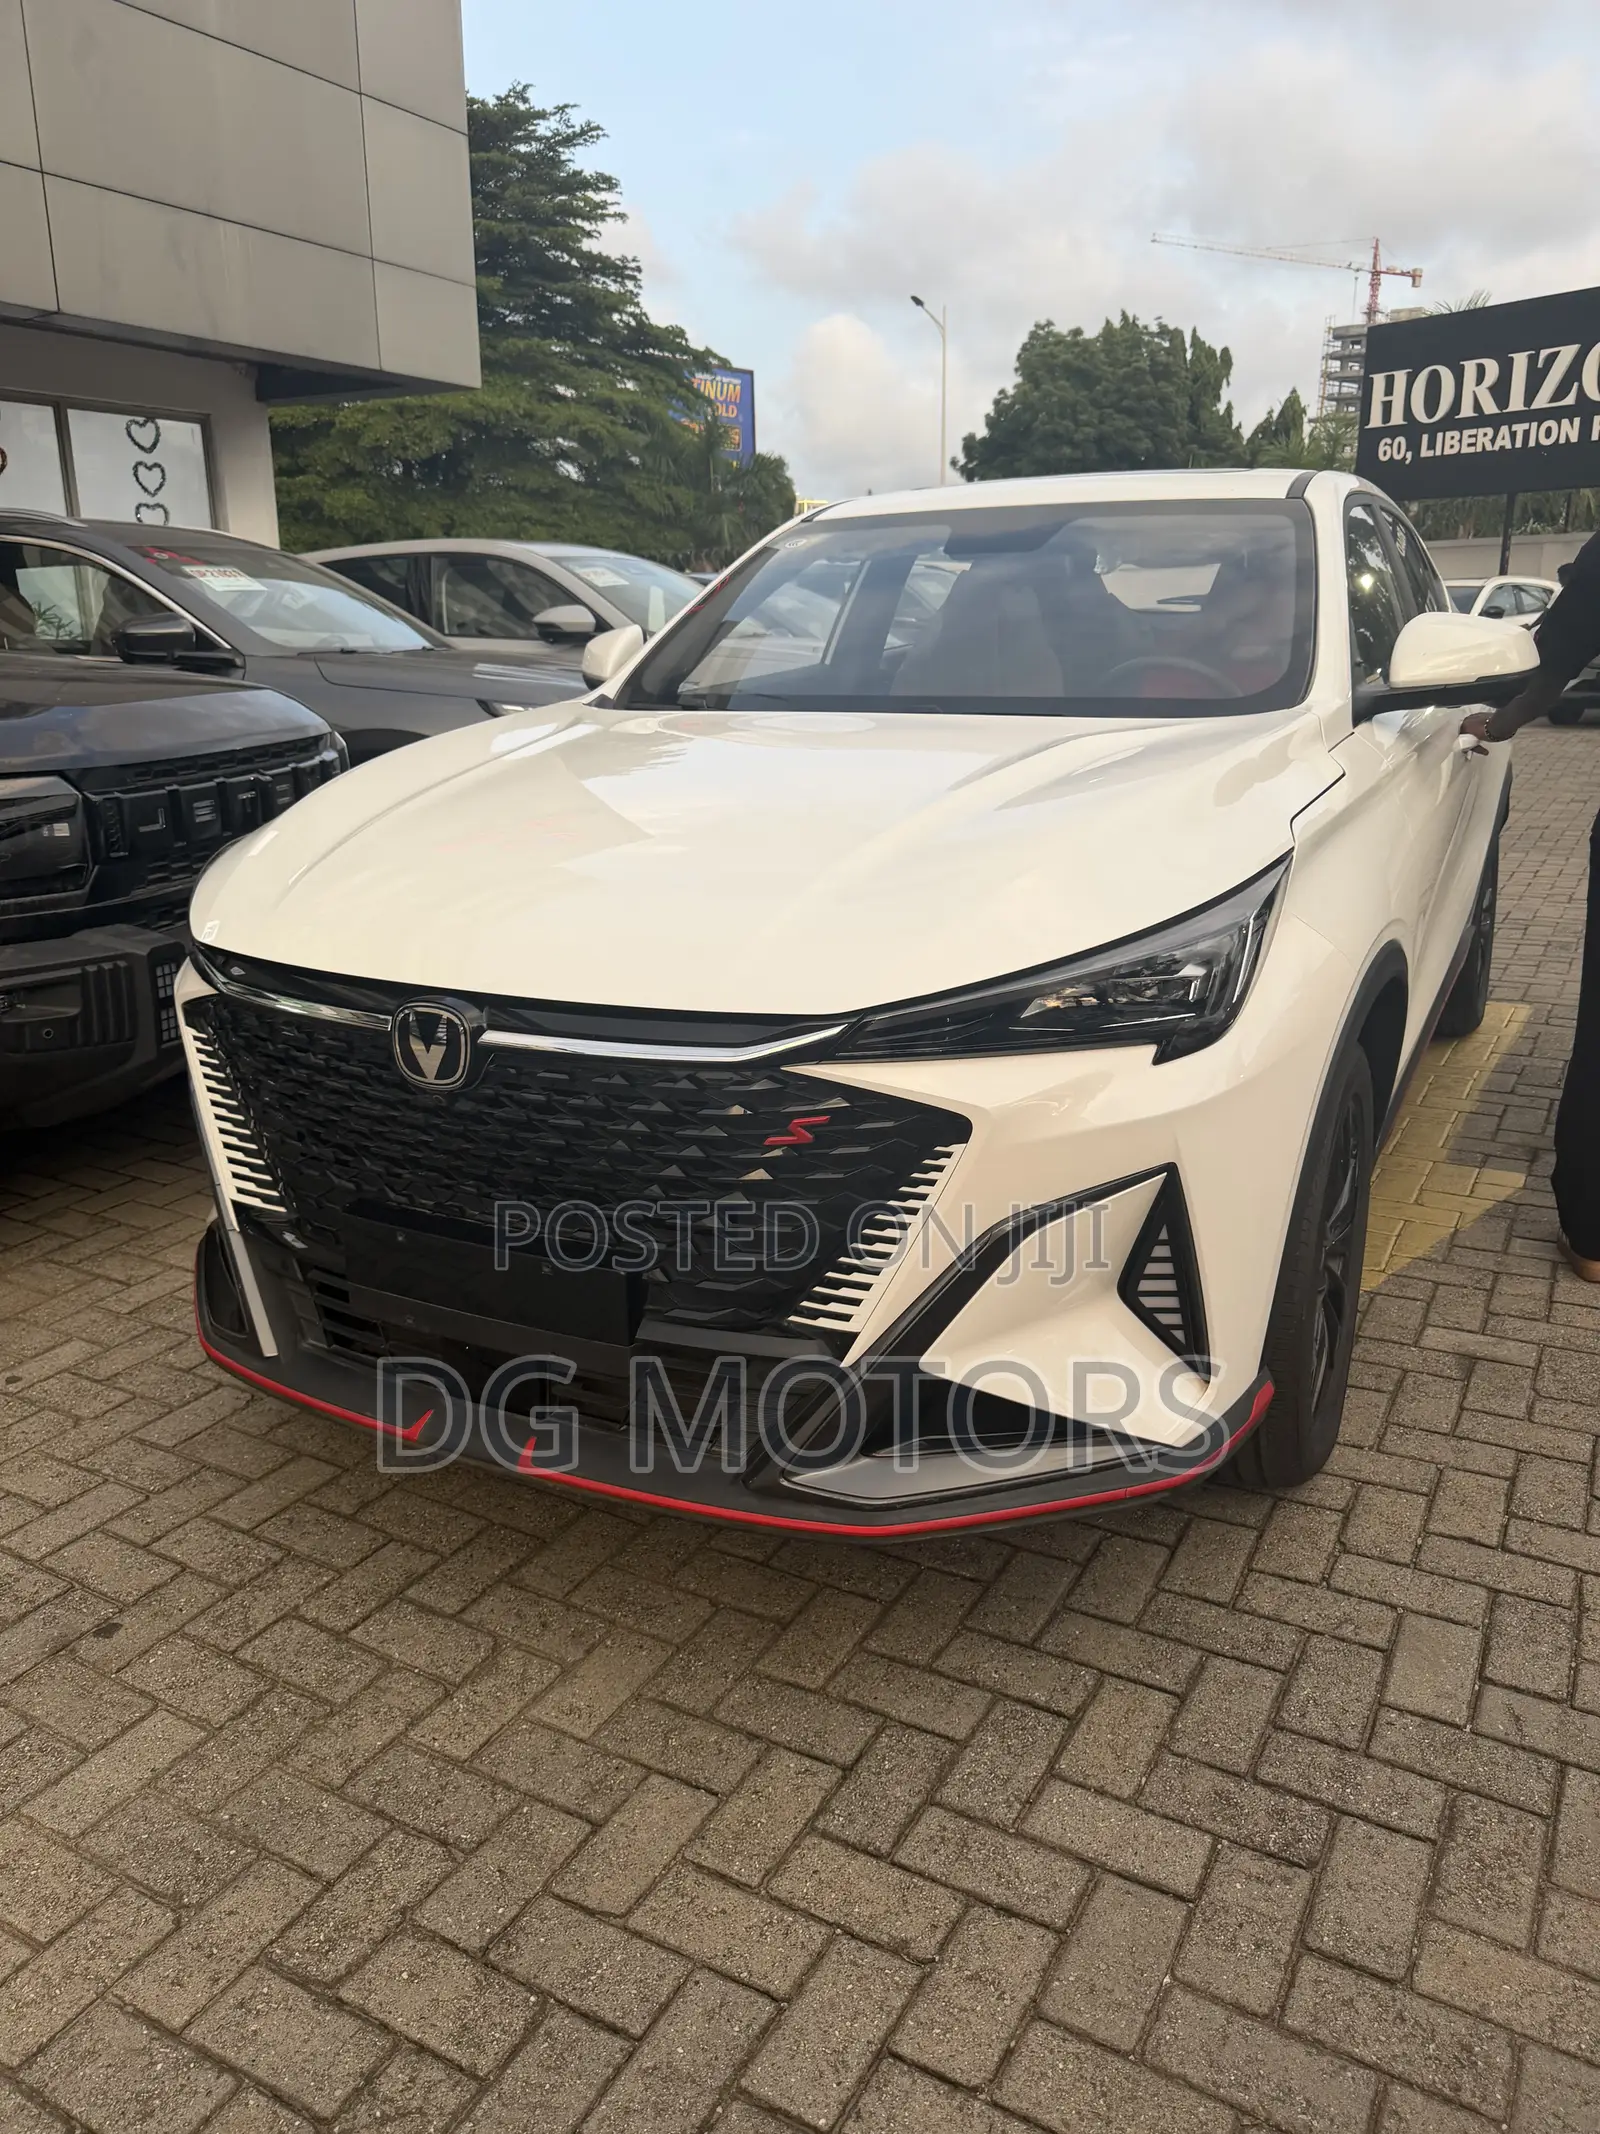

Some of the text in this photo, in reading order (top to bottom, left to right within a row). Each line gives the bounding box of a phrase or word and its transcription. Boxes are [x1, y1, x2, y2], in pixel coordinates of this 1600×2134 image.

[691, 378, 741, 403] TINUM
[1378, 436, 1412, 465] 60,
[1420, 417, 1580, 458] LIBERATION
